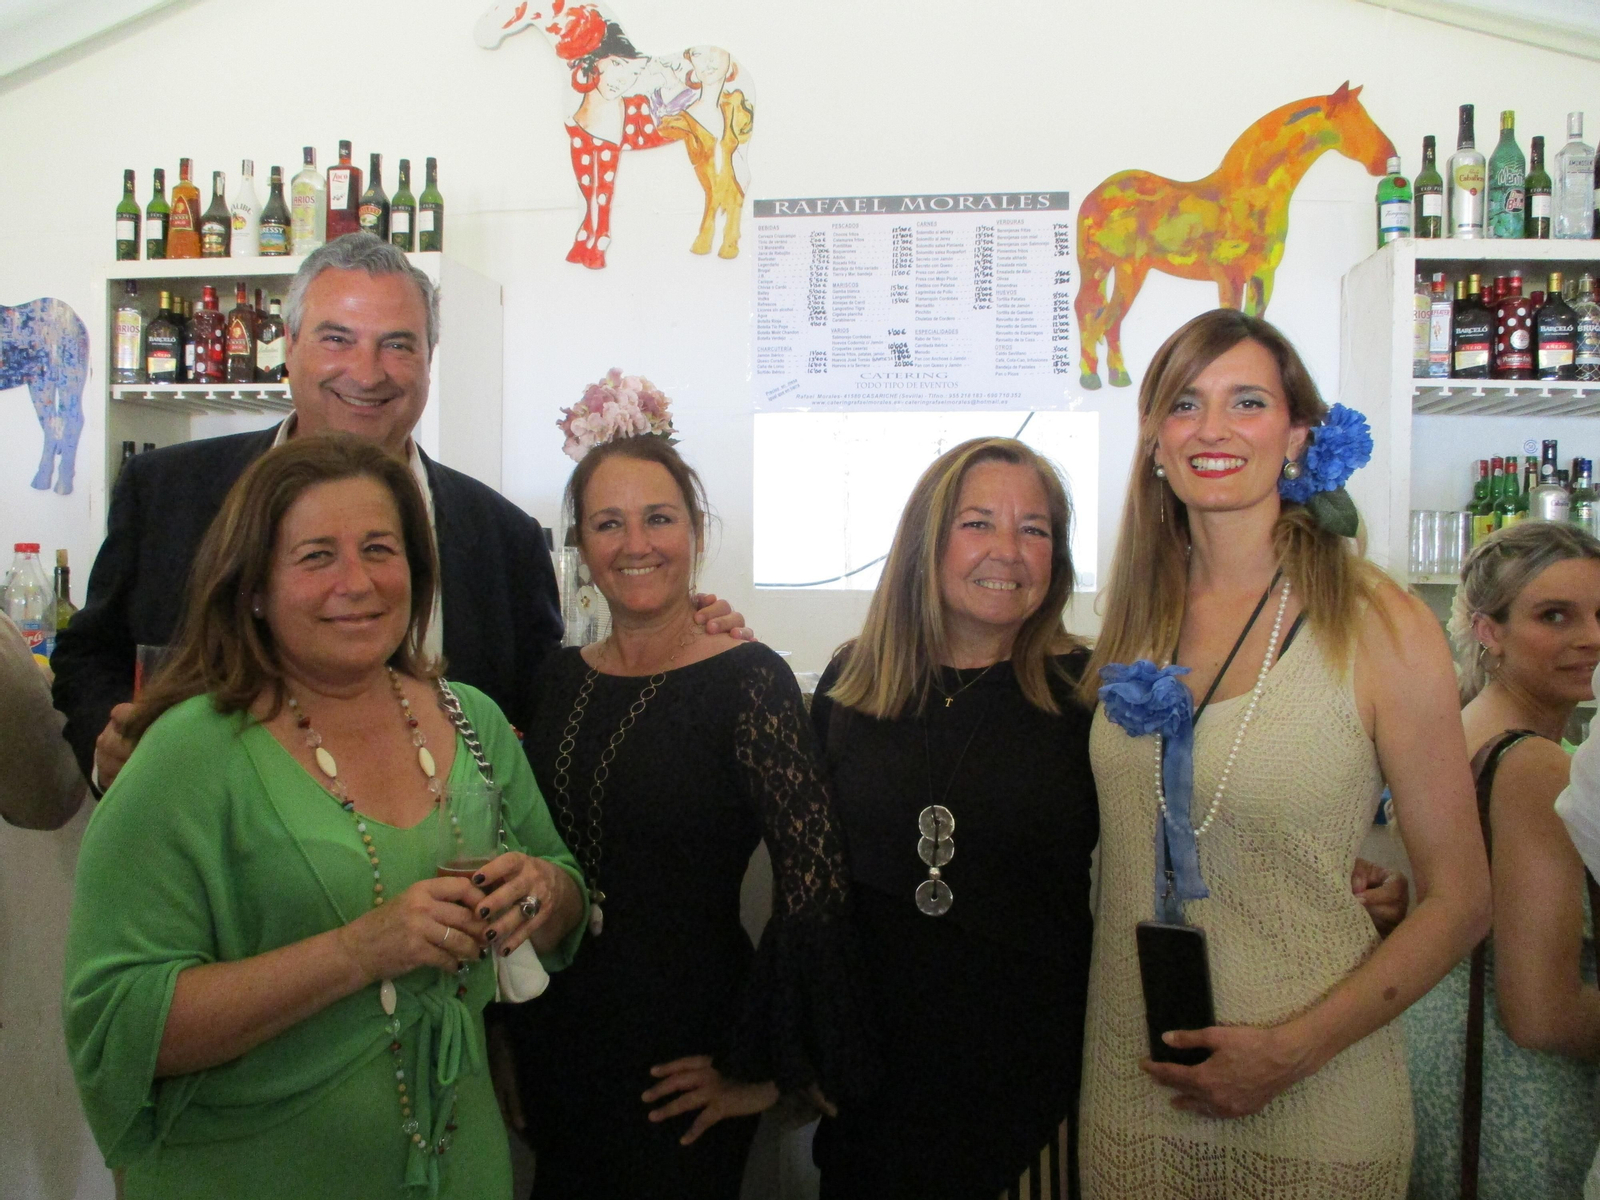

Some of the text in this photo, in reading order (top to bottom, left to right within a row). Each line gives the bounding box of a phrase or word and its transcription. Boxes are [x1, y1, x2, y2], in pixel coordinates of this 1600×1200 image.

[775, 194, 1050, 214] RAFAEL MORALES
[1456, 326, 1488, 334] BARCELÓ
